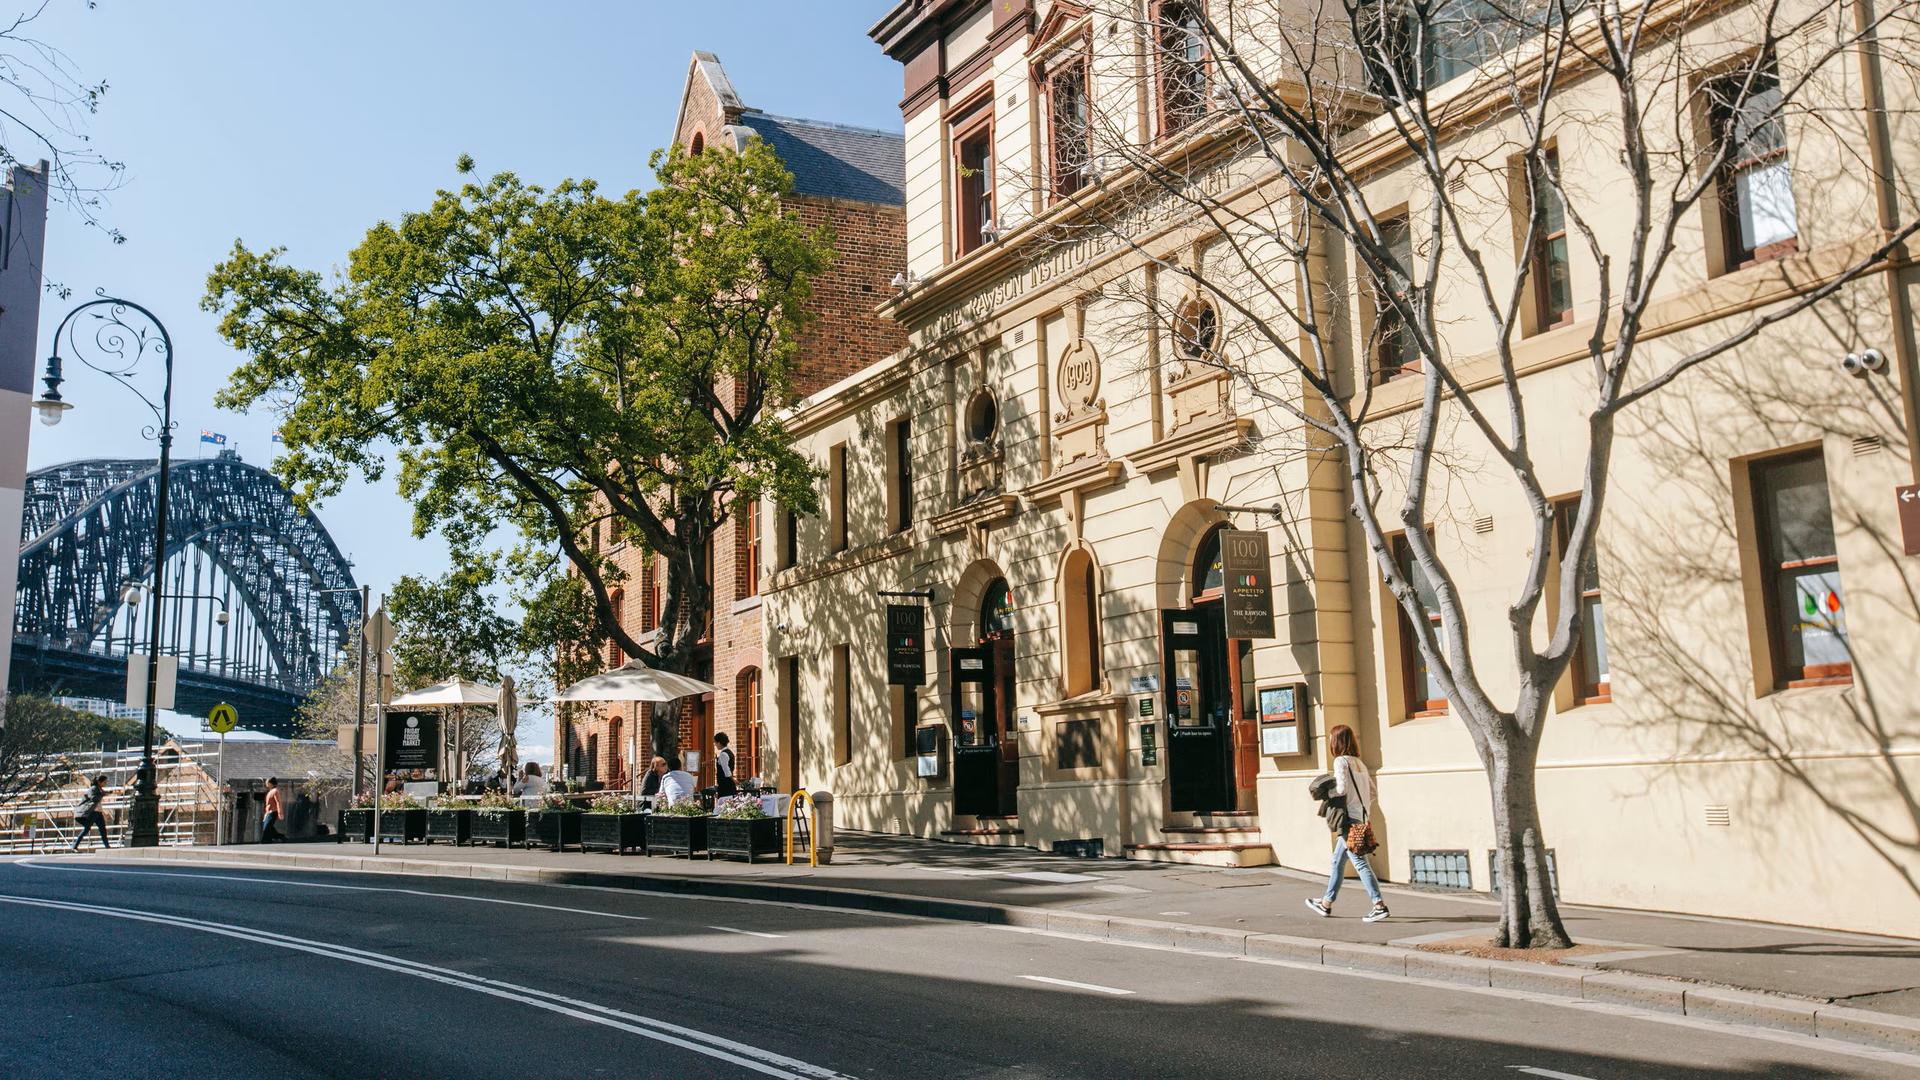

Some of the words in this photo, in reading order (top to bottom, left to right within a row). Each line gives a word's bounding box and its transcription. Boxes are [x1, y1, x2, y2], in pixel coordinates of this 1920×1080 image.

[969, 273, 1024, 317] RAWSON
[1029, 235, 1107, 289] INSTITUTE
[1066, 359, 1092, 391] 1909
[1232, 540, 1258, 558] 100
[895, 611, 916, 625] 100
